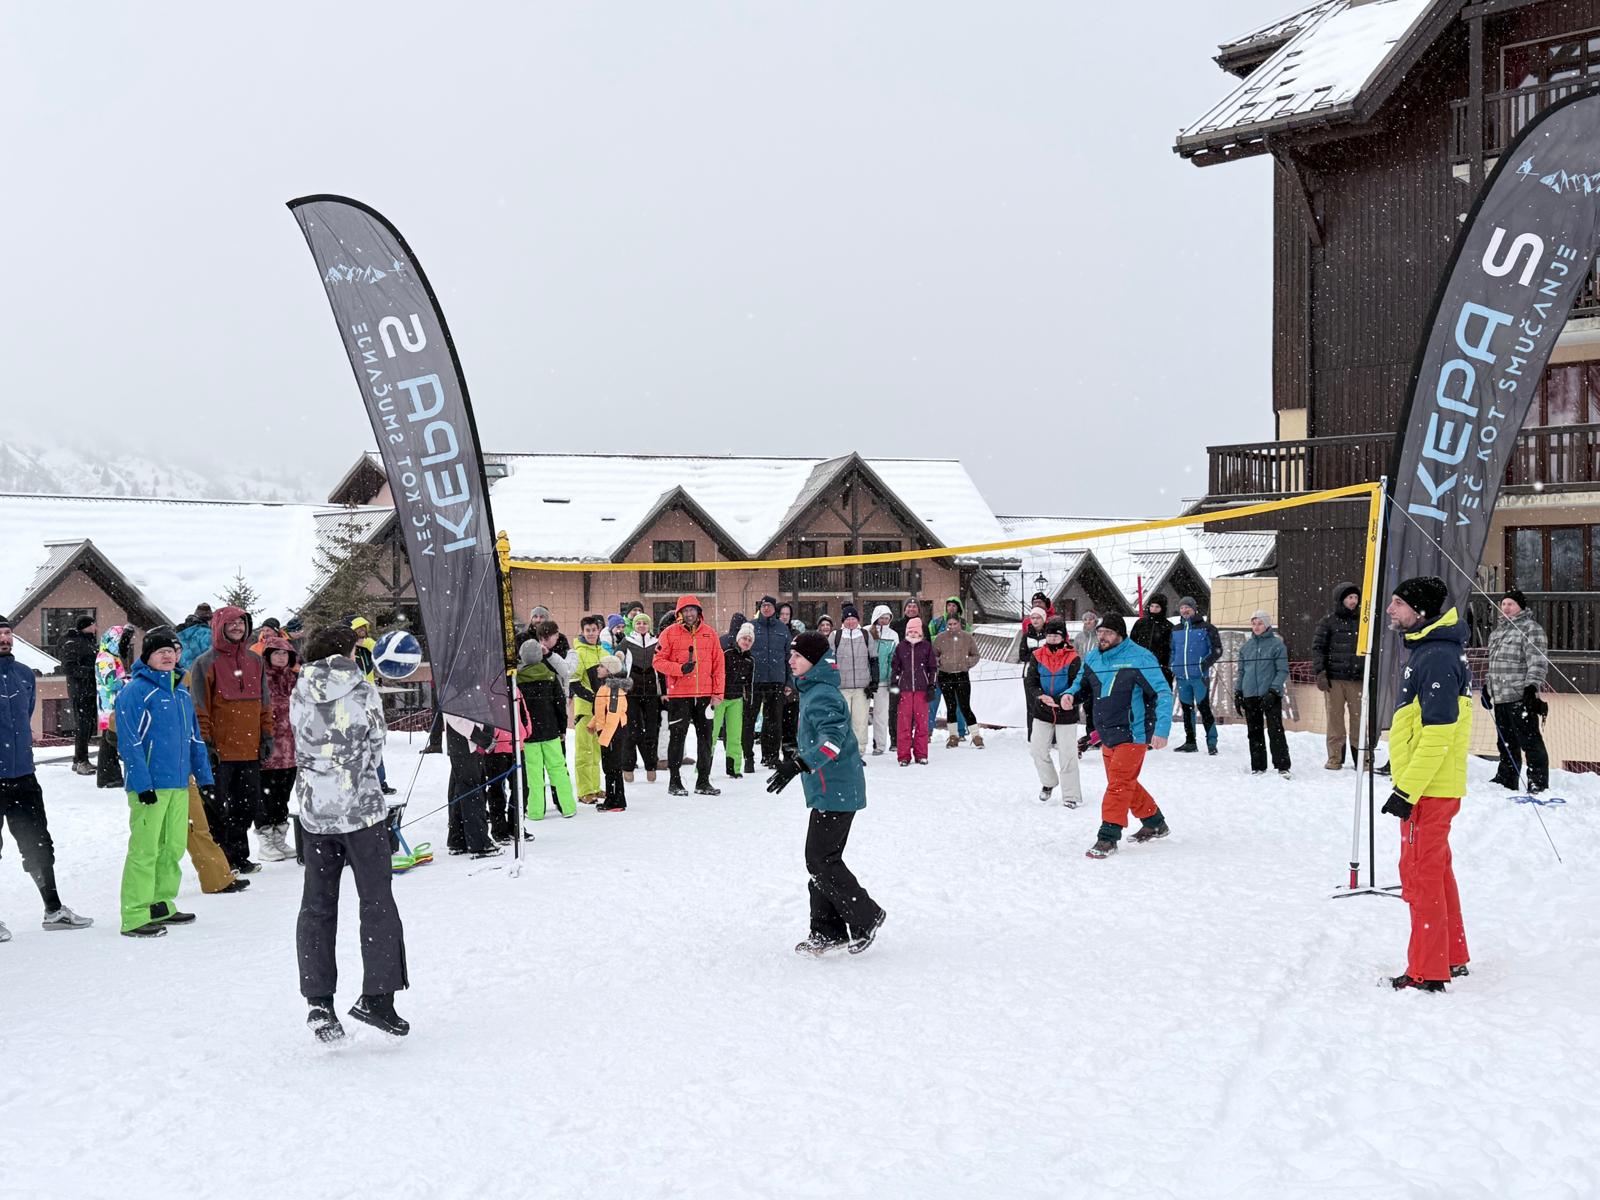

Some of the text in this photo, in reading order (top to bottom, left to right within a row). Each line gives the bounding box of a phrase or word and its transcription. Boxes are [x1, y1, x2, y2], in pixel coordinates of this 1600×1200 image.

[1408, 227, 1544, 520] KEPA S
[1456, 243, 1578, 526] VEČ KOT SMUČANJE
